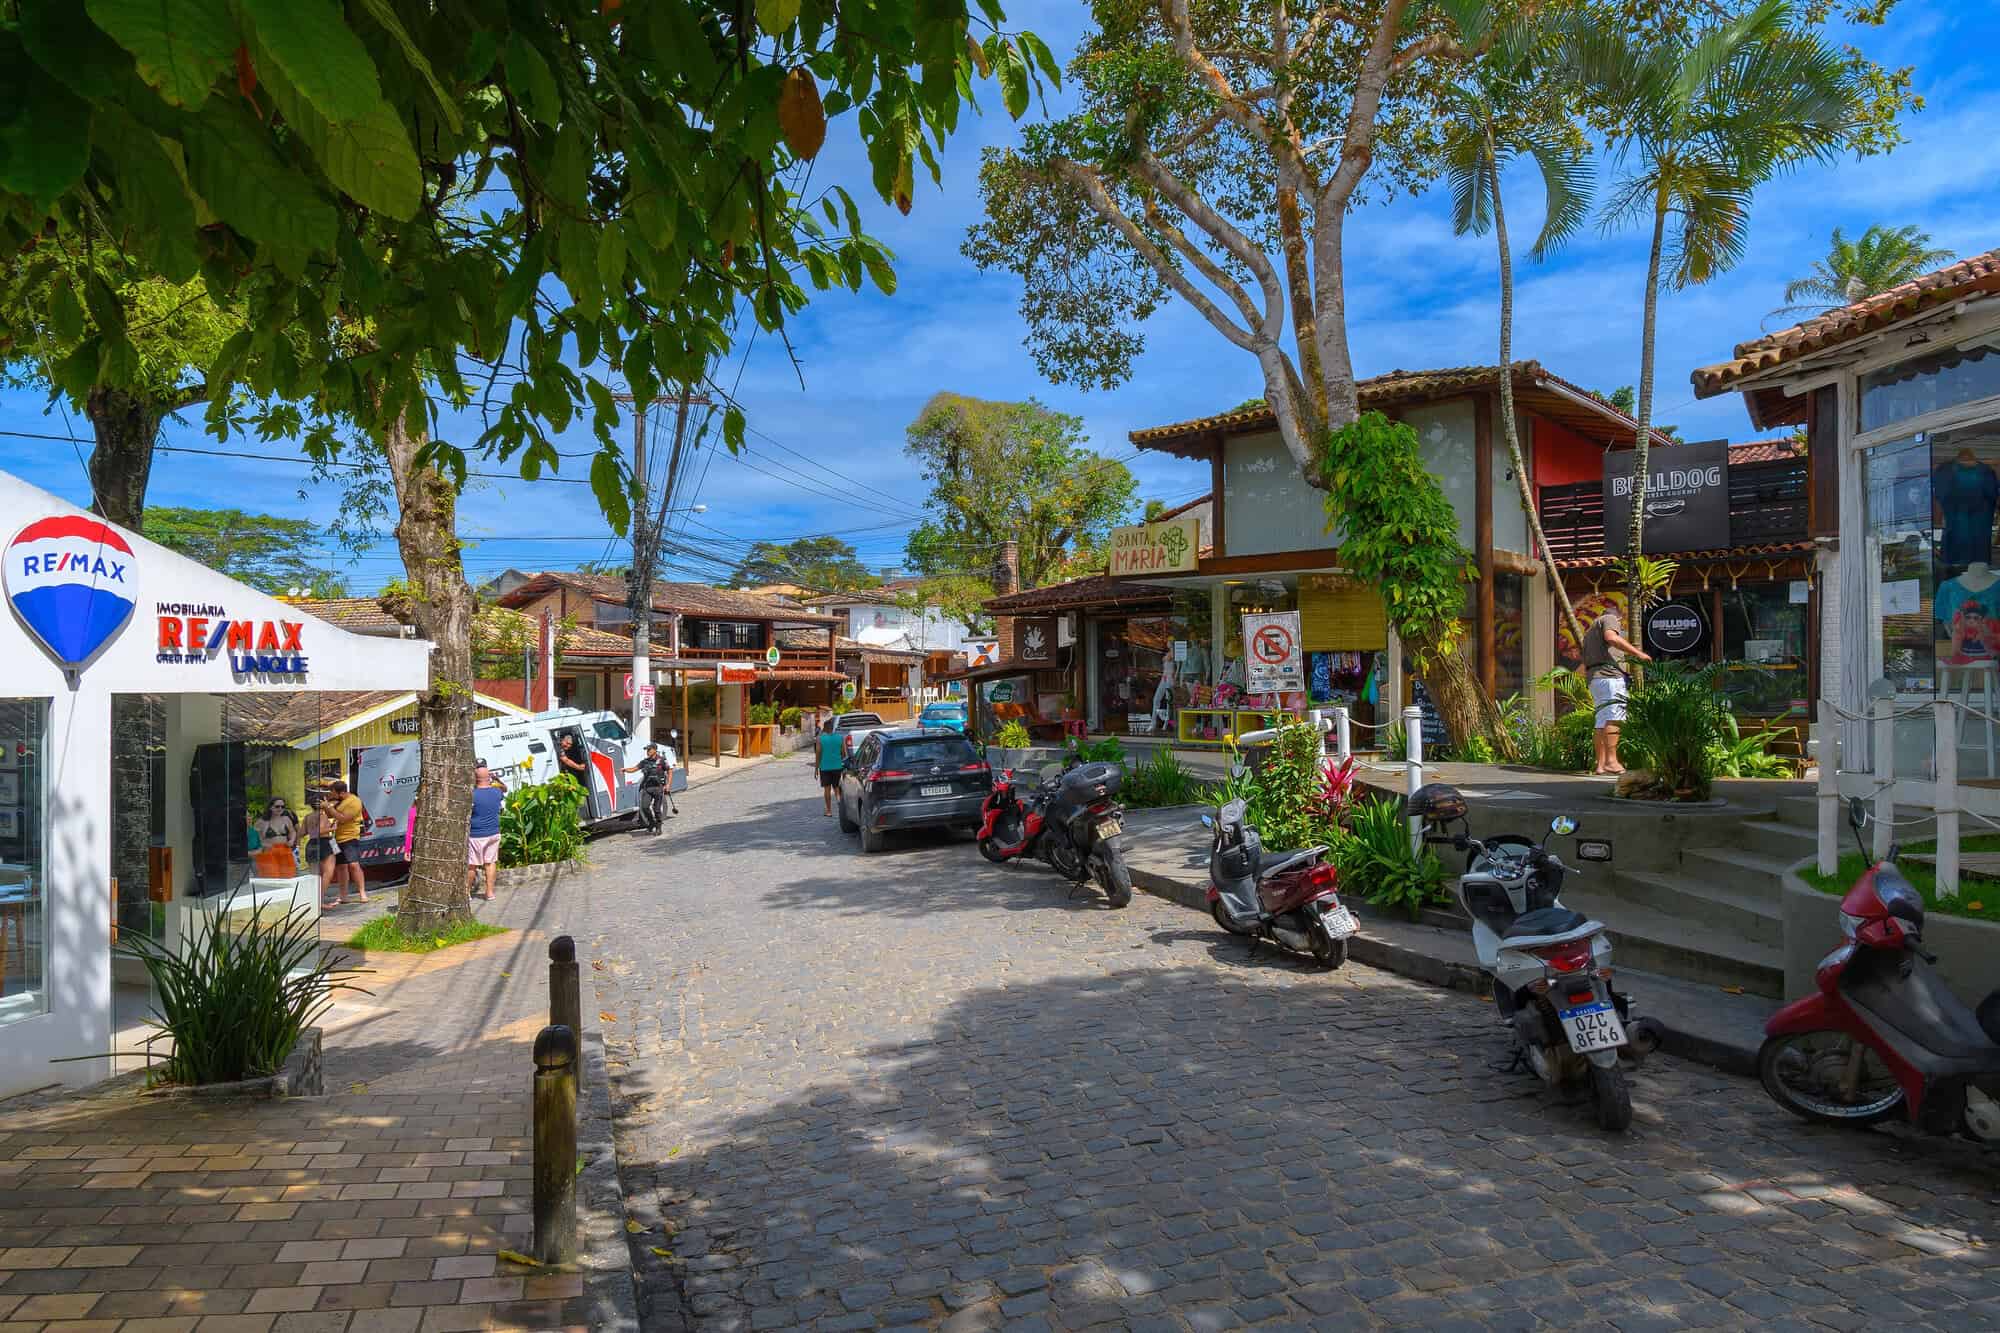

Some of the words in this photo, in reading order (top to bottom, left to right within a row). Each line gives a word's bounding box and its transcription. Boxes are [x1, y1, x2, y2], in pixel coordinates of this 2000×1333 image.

[1118, 530, 1150, 547] SANTA
[24, 552, 126, 583] RE/MAX
[156, 602, 226, 617] IMOBILIÁRIA
[158, 616, 304, 651] RE/MAX
[233, 656, 309, 673] UNIQUE
[1575, 1026, 1619, 1048] 8F46
